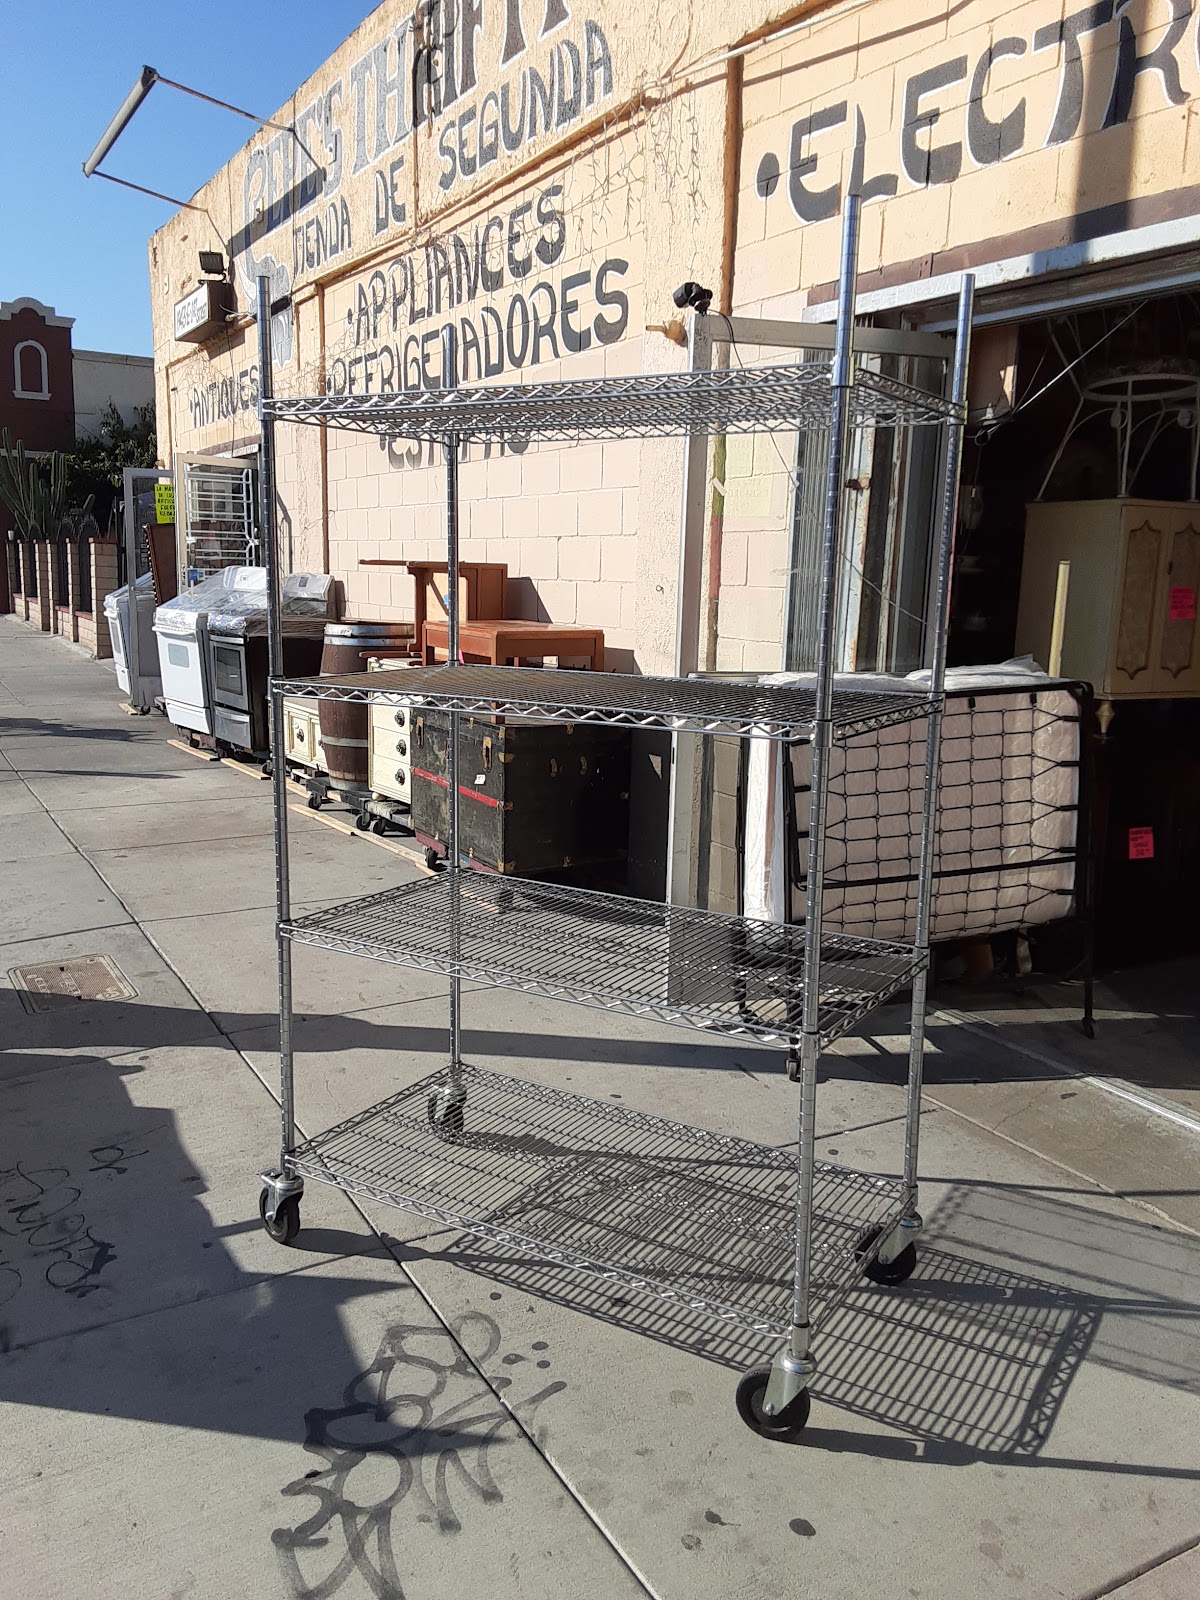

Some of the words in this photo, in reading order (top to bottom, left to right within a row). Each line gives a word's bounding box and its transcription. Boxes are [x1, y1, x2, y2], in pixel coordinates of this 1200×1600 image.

[294, 195, 351, 276] TIENDA
[375, 156, 405, 235] DE
[438, 19, 613, 191] SEGUNDA
[788, 0, 1200, 222] ELECTR
[333, 258, 629, 395] REFRIGEADORES
[355, 185, 567, 346] APPLIANCES
[193, 365, 259, 428] ANTIQUES
